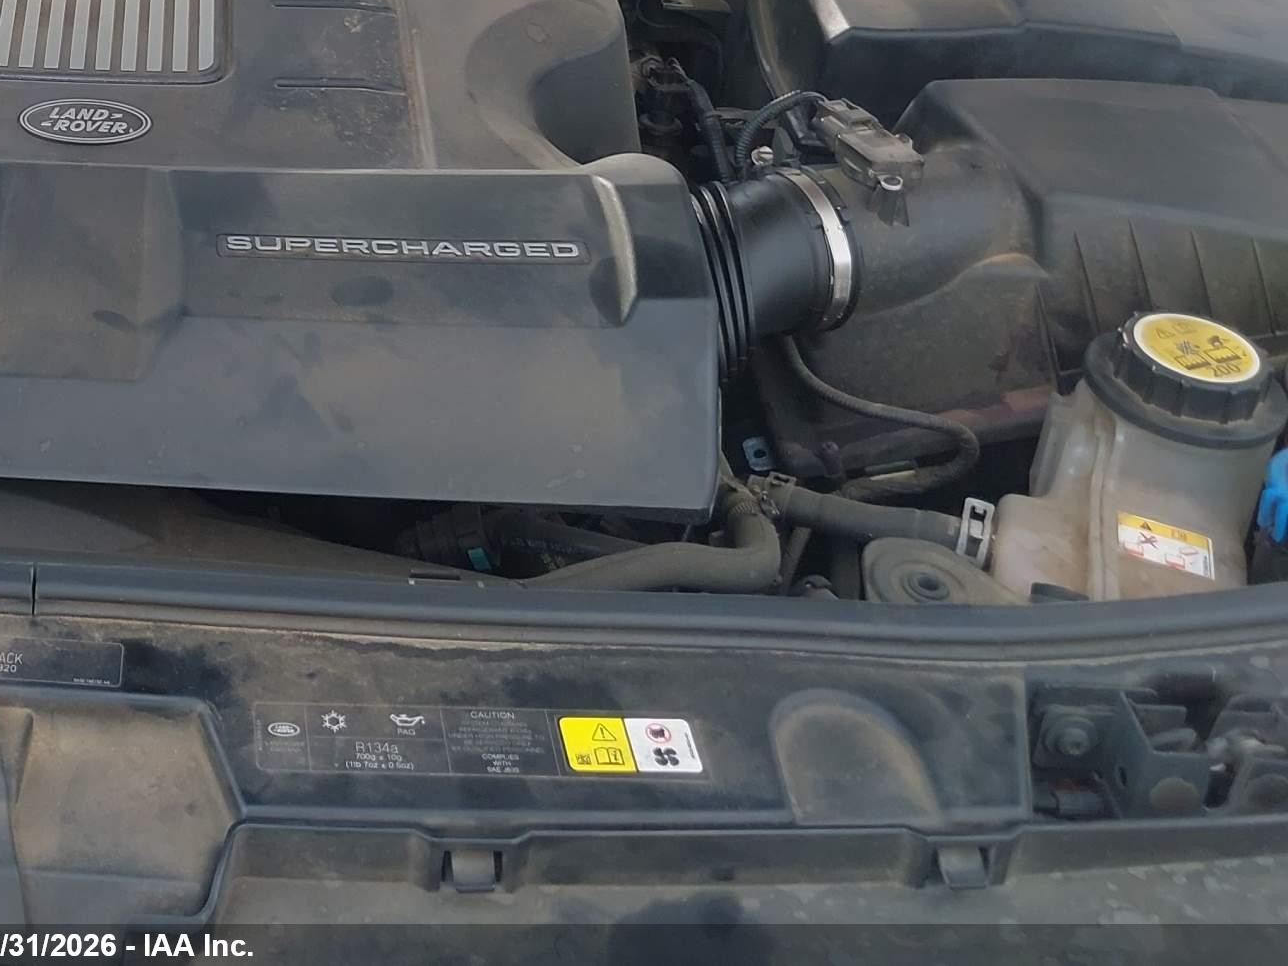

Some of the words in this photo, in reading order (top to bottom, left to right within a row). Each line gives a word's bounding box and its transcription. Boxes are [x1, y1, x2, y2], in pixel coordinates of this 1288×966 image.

[49, 107, 110, 121] LAND
[53, 120, 128, 134] ROVER
[225, 235, 580, 258] SUPERCHARGED
[470, 710, 515, 720] CAUTION
[397, 728, 416, 736] PAG
[355, 741, 399, 754] R134a
[355, 753, 376, 761] 700g
[387, 754, 403, 762] 10g
